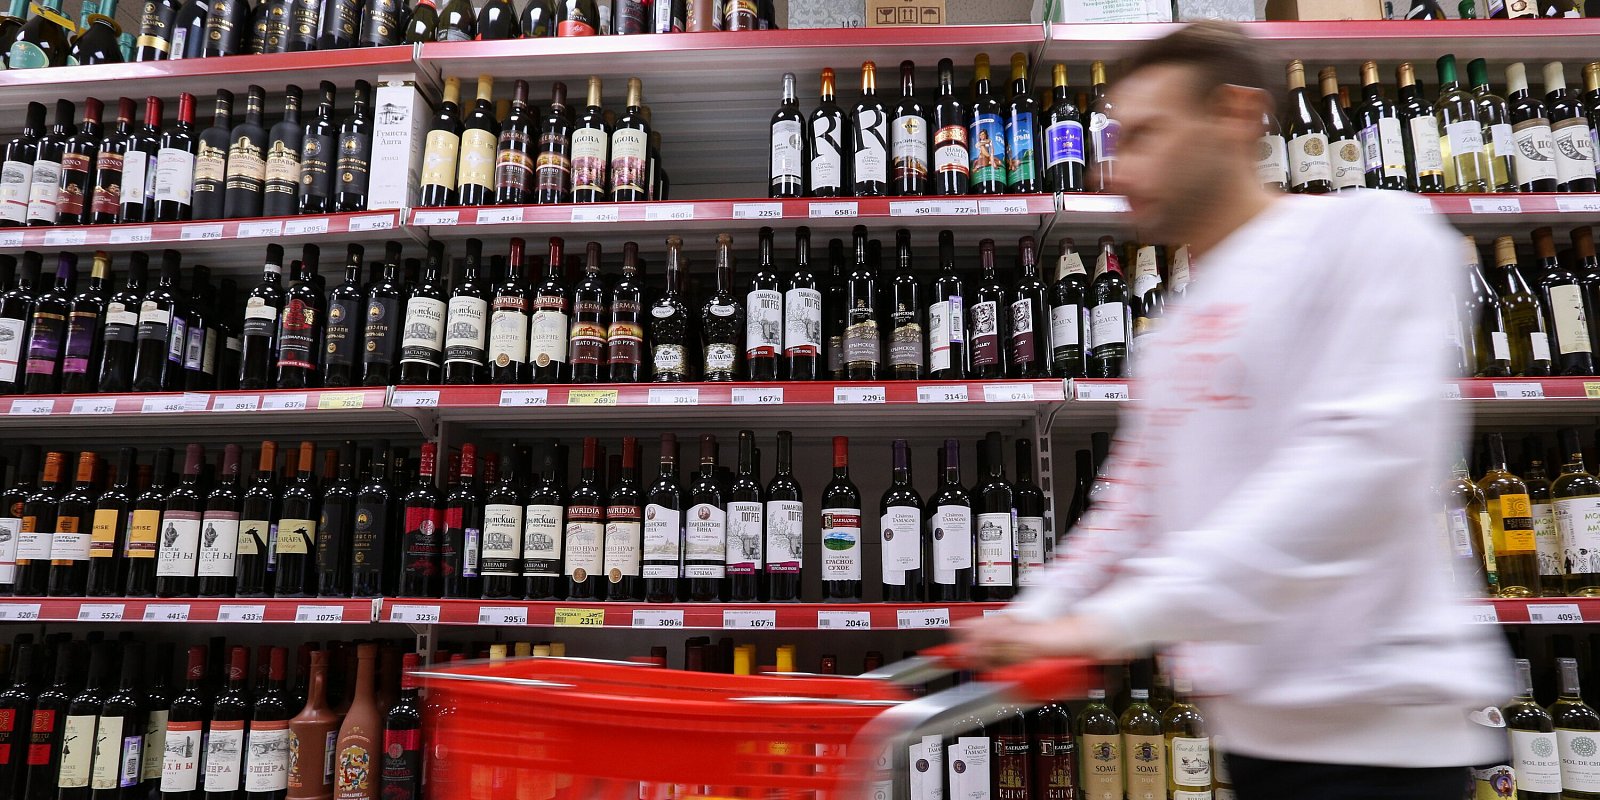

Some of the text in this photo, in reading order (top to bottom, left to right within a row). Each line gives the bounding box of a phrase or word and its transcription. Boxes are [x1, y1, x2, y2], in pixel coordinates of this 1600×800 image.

[574, 135, 600, 144] AGORA
[614, 136, 640, 145] AGORA
[1010, 392, 1026, 400] 674
[568, 507, 600, 515] TAVRIDIA
[17, 611, 30, 619] 520
[101, 611, 115, 619] 552
[166, 611, 180, 619] 441
[241, 613, 256, 621] 433
[415, 613, 430, 621] 323
[503, 615, 518, 623] 295
[1557, 613, 1573, 621] 409
[580, 617, 594, 625] 231
[249, 764, 286, 773] ЭШЕРА
[1095, 765, 1117, 773] SOAVE
[1136, 765, 1159, 773] SOAVE
